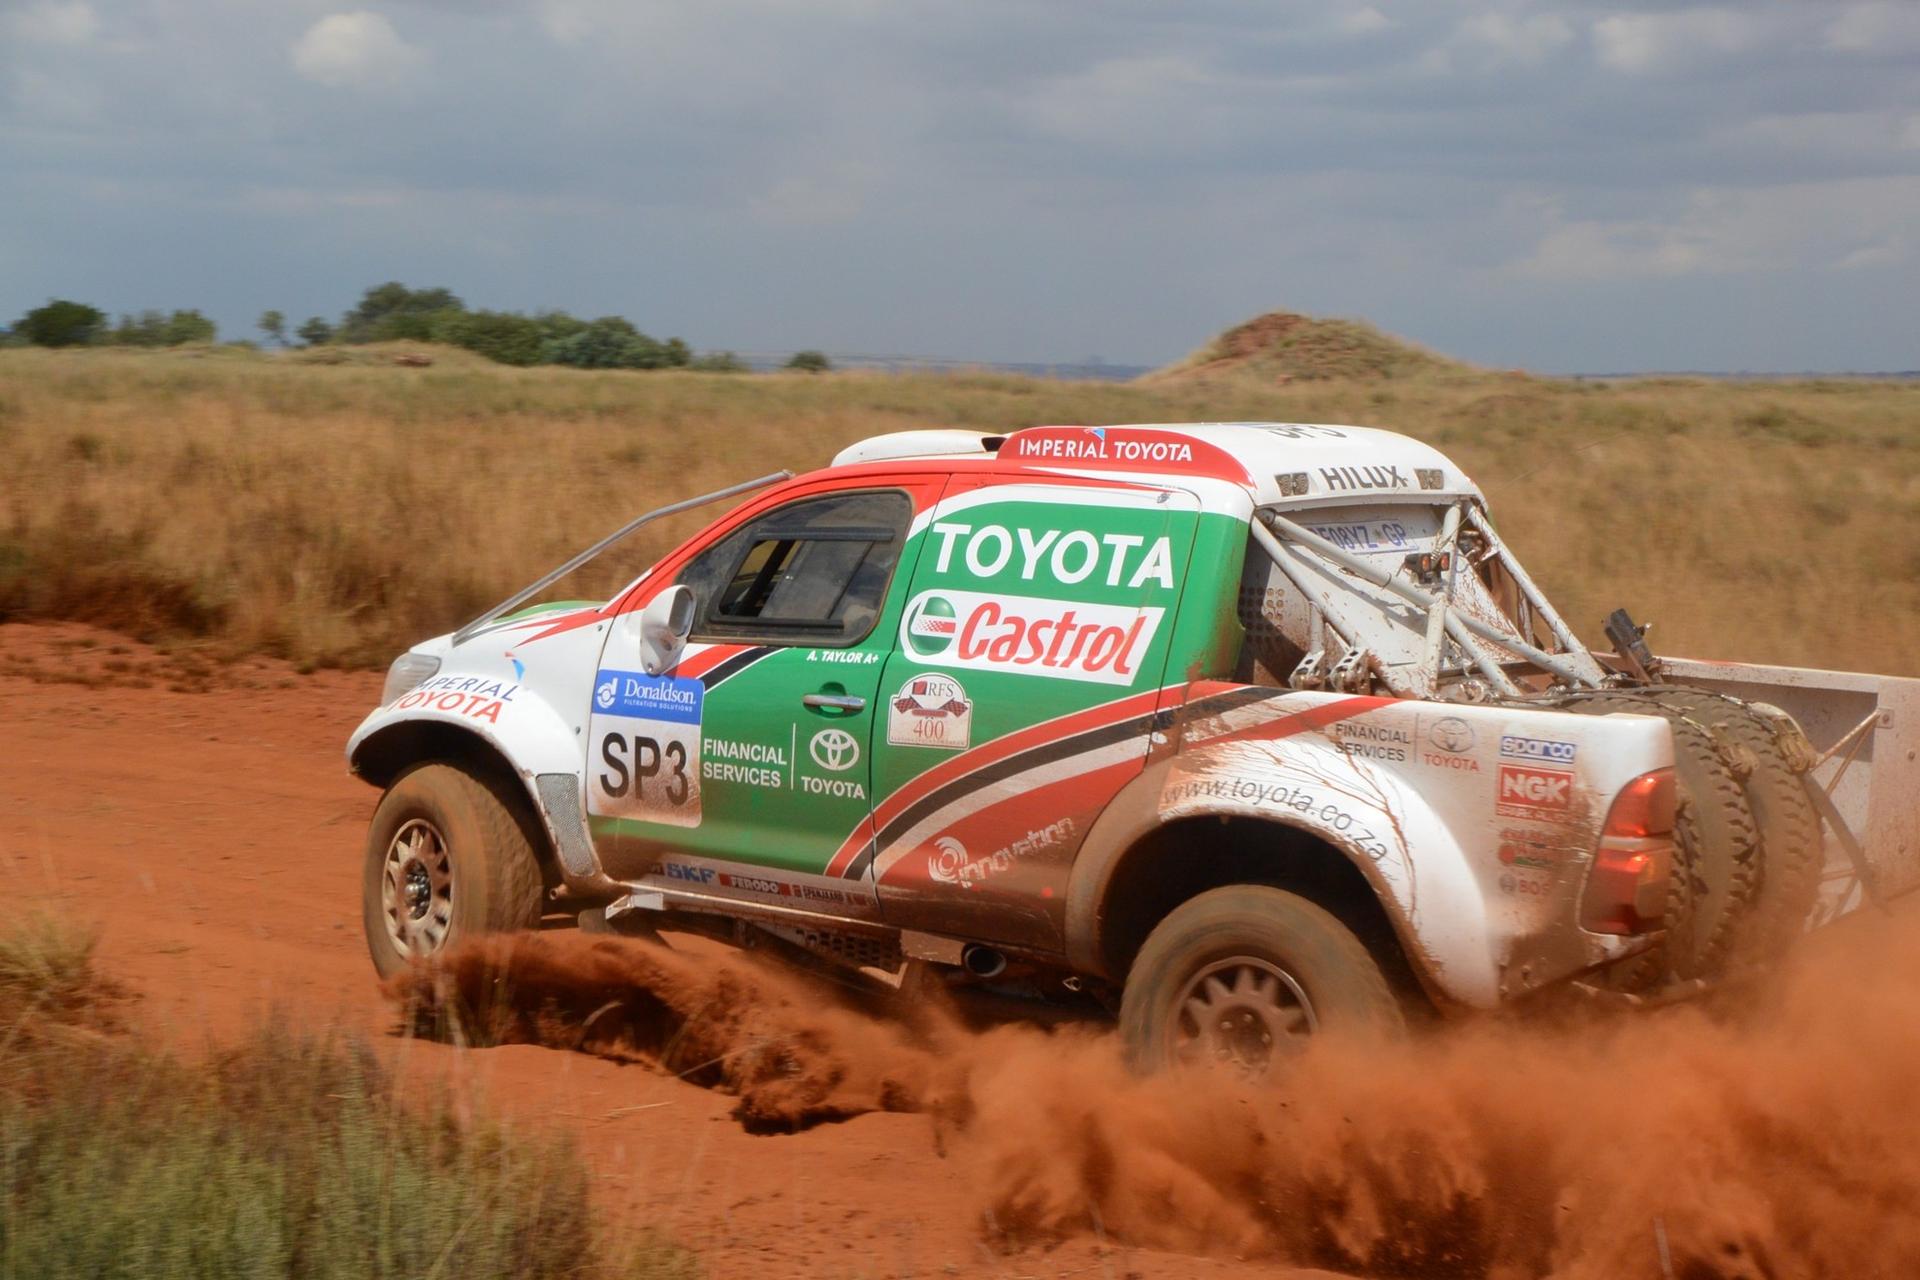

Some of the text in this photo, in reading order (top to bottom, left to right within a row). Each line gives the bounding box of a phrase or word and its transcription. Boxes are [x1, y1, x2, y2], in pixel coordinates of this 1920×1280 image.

[1019, 438, 1192, 461] IMPERIAL TOYOTA
[1319, 465, 1407, 490] HILUX
[1382, 523, 1408, 546] GP
[933, 522, 1174, 589] TOYOTA
[958, 602, 1147, 676] Castrol
[821, 651, 861, 664] TAYLOR
[864, 653, 879, 664] A+
[928, 682, 954, 697] RFS
[624, 699, 693, 713] FILTRATION SOLUTIONS
[913, 720, 944, 740] 400
[1335, 723, 1411, 745] FINANCIAL
[703, 738, 787, 765] FINANCIAL
[1334, 741, 1405, 762] SERVICES
[1502, 737, 1574, 758] sparco
[600, 732, 689, 806] SP3
[1424, 753, 1480, 772] TOYOTA
[703, 762, 781, 788] SERVICES
[801, 776, 865, 800] TOYOTA
[1502, 772, 1569, 804] NGK
[1164, 777, 1388, 862] www.toyota.co.za
[666, 862, 715, 884] SKF
[731, 874, 779, 894] FERODO
